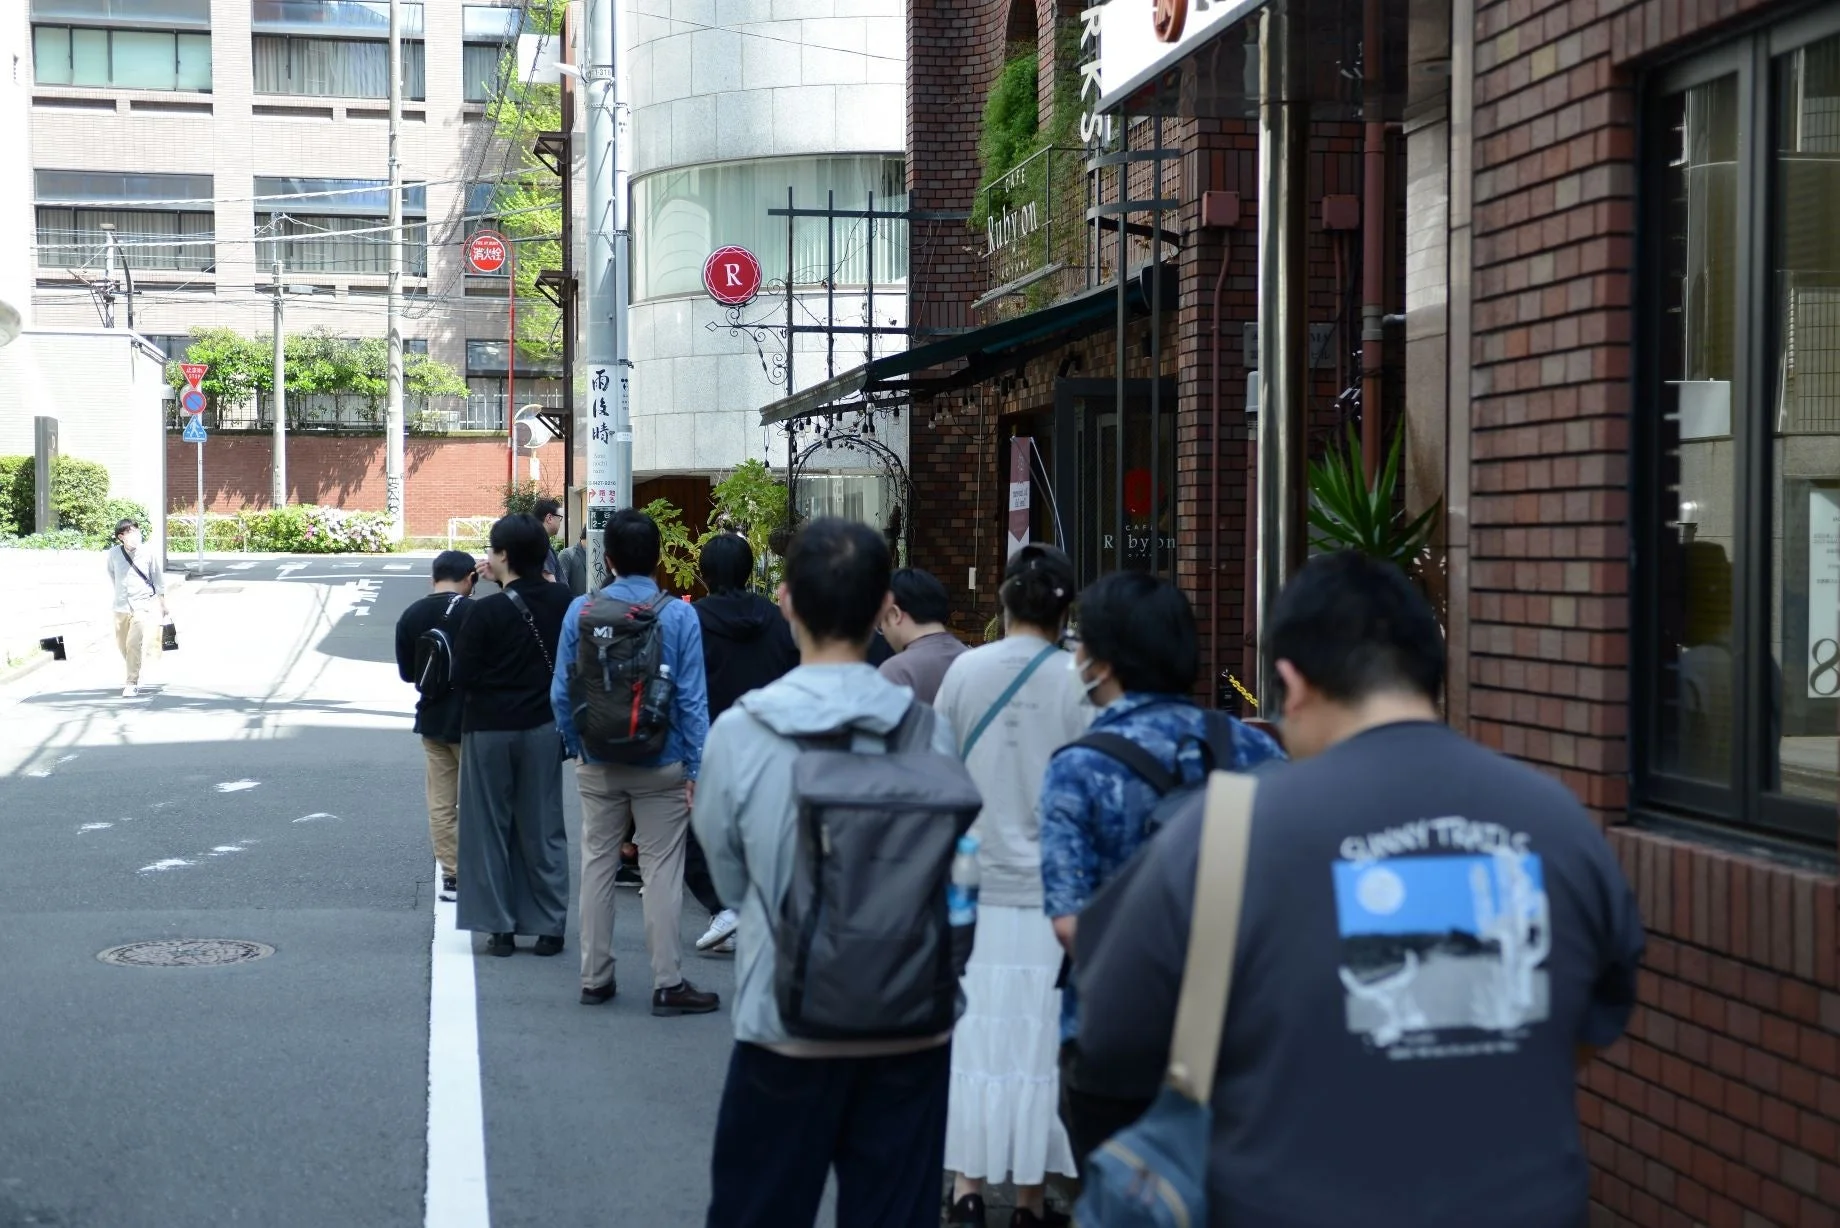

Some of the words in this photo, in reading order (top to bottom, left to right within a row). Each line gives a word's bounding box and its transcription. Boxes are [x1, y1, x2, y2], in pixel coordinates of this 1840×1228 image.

[1006, 168, 1025, 193] CAFE
[988, 204, 1018, 253] Ruby
[1022, 200, 1038, 235] on
[473, 247, 502, 260] 消火栓
[724, 263, 743, 286] R
[1103, 534, 1149, 552] Rby
